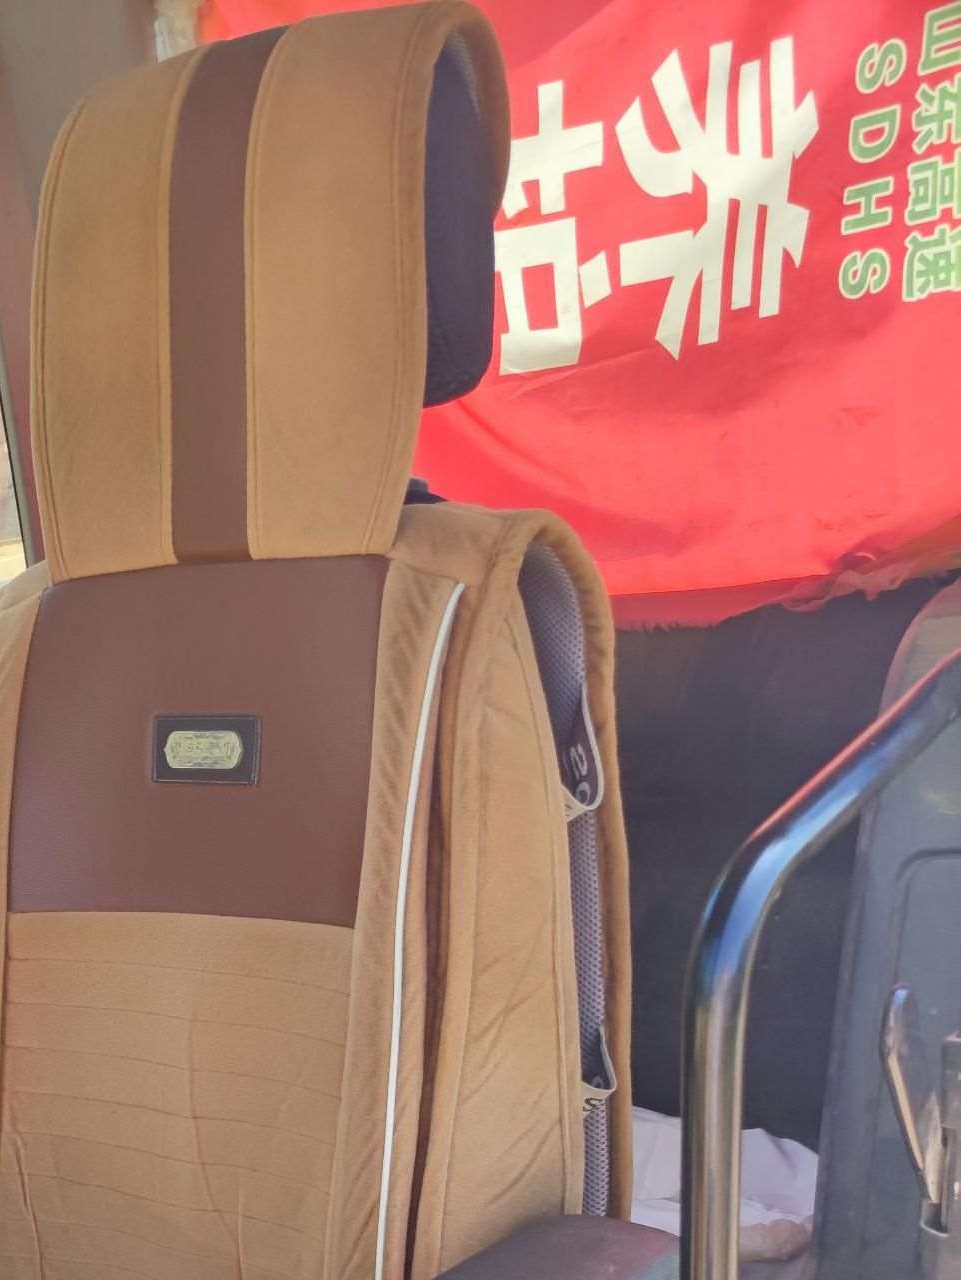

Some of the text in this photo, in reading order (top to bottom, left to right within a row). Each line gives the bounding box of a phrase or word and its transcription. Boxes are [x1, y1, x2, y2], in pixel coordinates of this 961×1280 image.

[838, 38, 907, 300] SDHS
[902, 0, 961, 302] 山东高速
